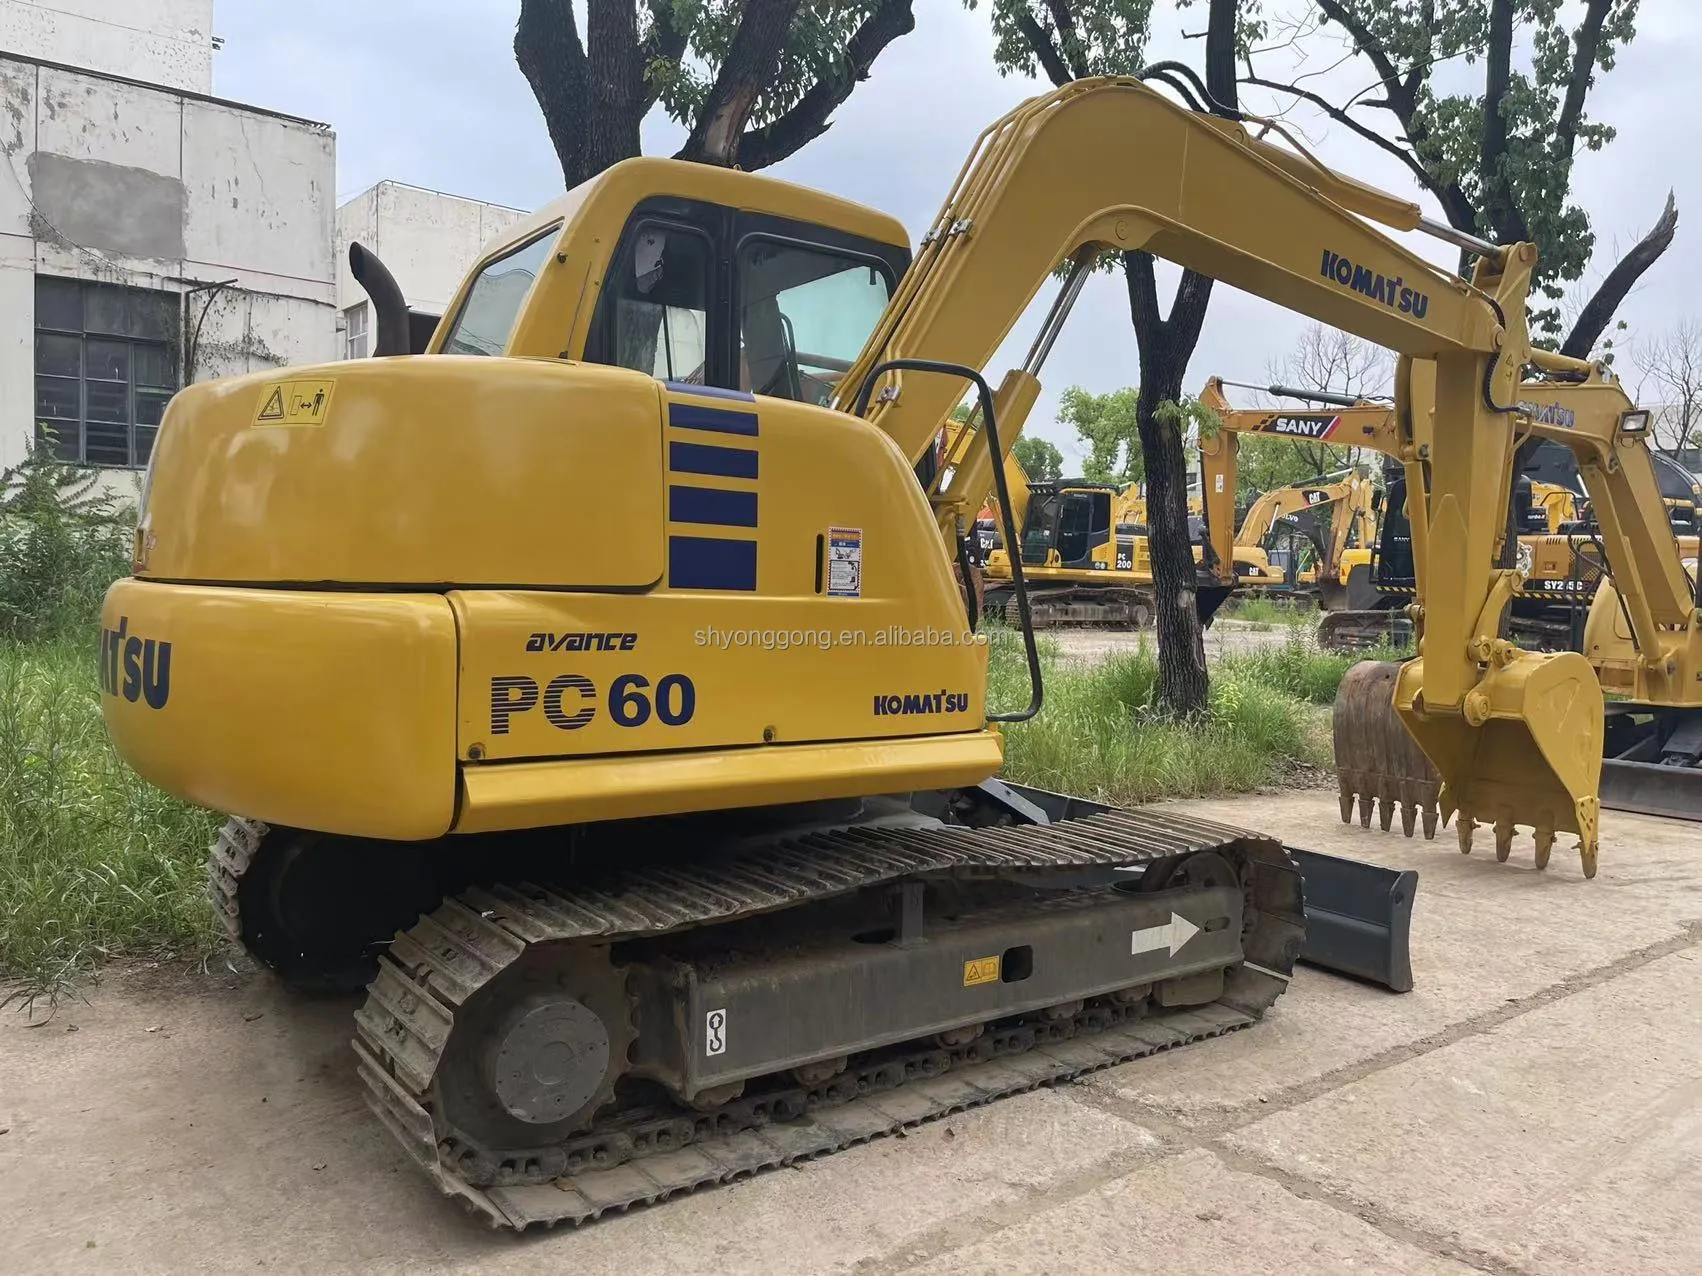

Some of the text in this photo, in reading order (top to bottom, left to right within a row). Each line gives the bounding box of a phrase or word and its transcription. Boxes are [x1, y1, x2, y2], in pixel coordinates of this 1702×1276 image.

[1320, 249, 1428, 319] KOMATSU
[1276, 418, 1322, 435] SANY
[1308, 491, 1321, 504] CAT
[1116, 560, 1132, 569] 200
[525, 632, 637, 651] avance
[873, 689, 968, 715] KOMATSU
